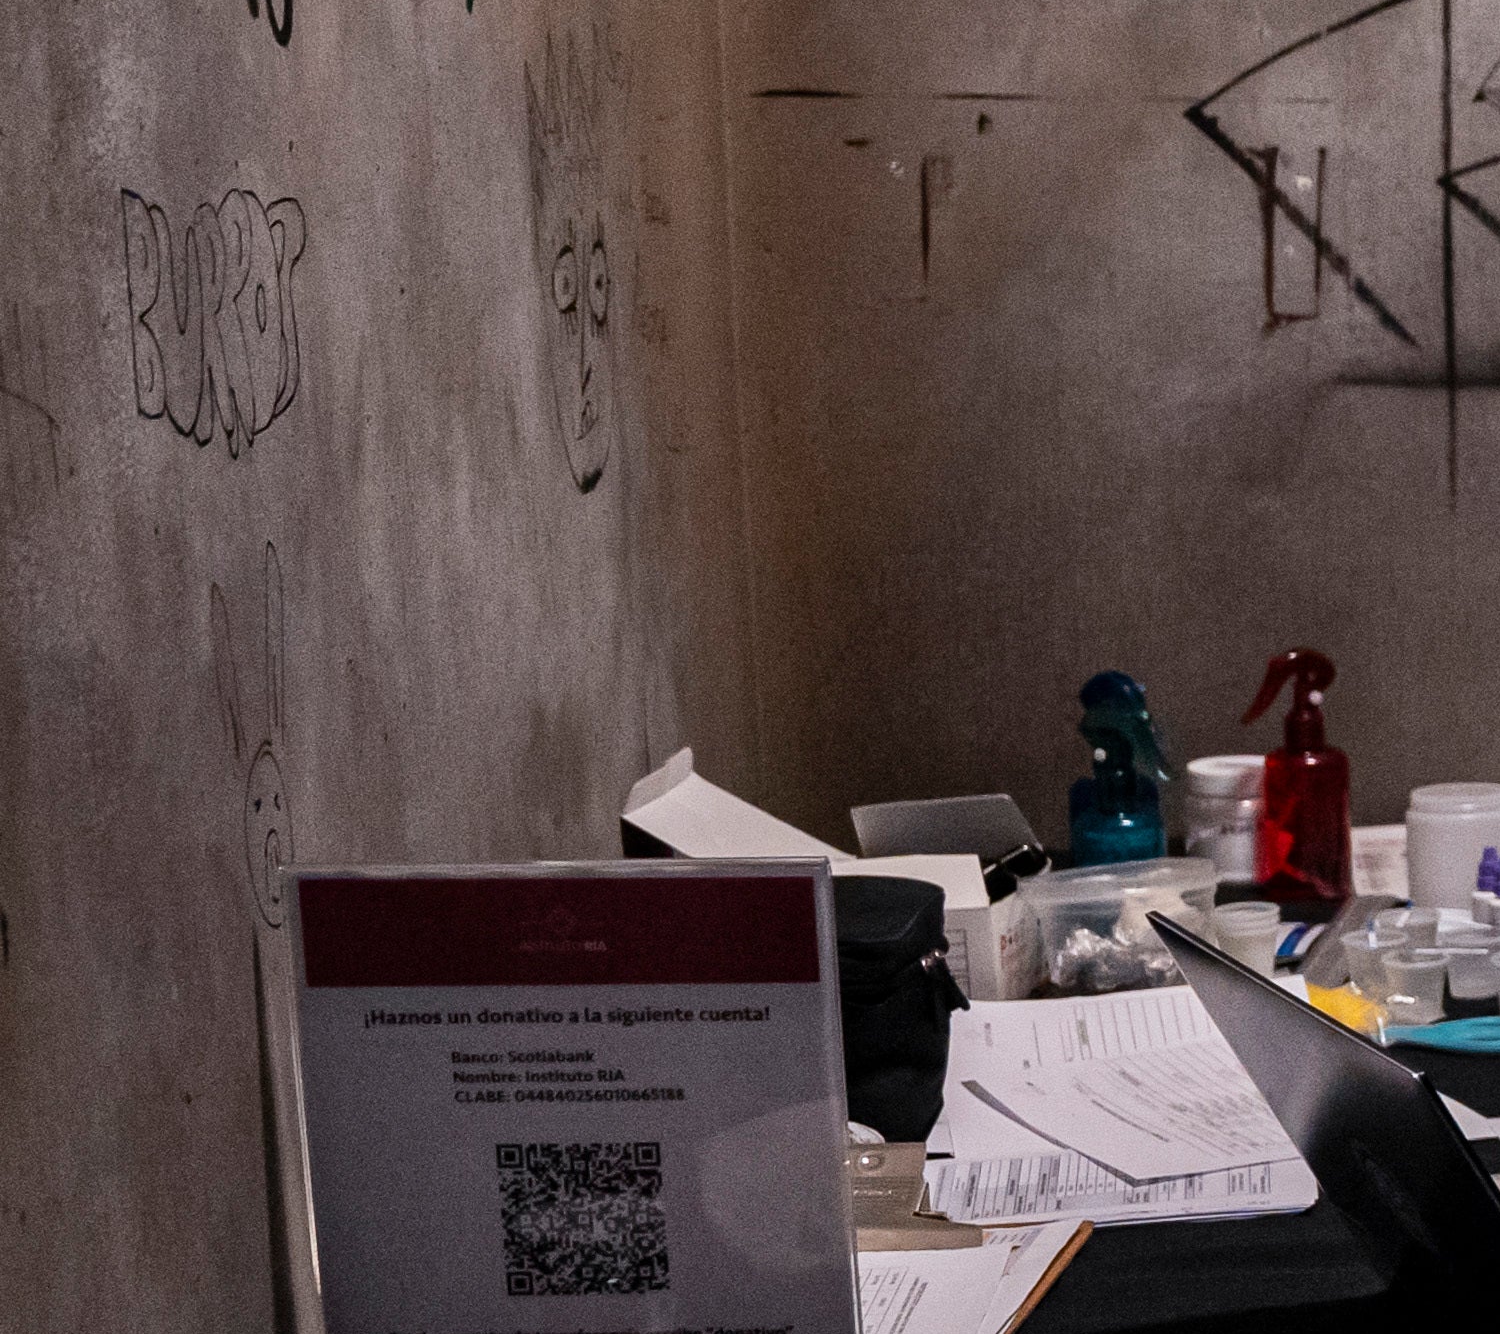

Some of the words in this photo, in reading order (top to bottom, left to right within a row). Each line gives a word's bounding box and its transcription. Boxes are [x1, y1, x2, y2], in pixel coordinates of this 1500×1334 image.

[364, 1008, 442, 1029] ¡Haznos
[447, 1011, 472, 1025] un
[477, 1008, 564, 1025] donativo
[568, 1012, 580, 1024] a
[584, 1007, 602, 1023] la
[606, 1007, 694, 1027] siguiente
[698, 1007, 771, 1023] cuenta!
[451, 1050, 504, 1065] Banco:
[508, 1049, 595, 1064] Scotiabank
[452, 1069, 522, 1084] Nombre:
[597, 1068, 626, 1083] RIA
